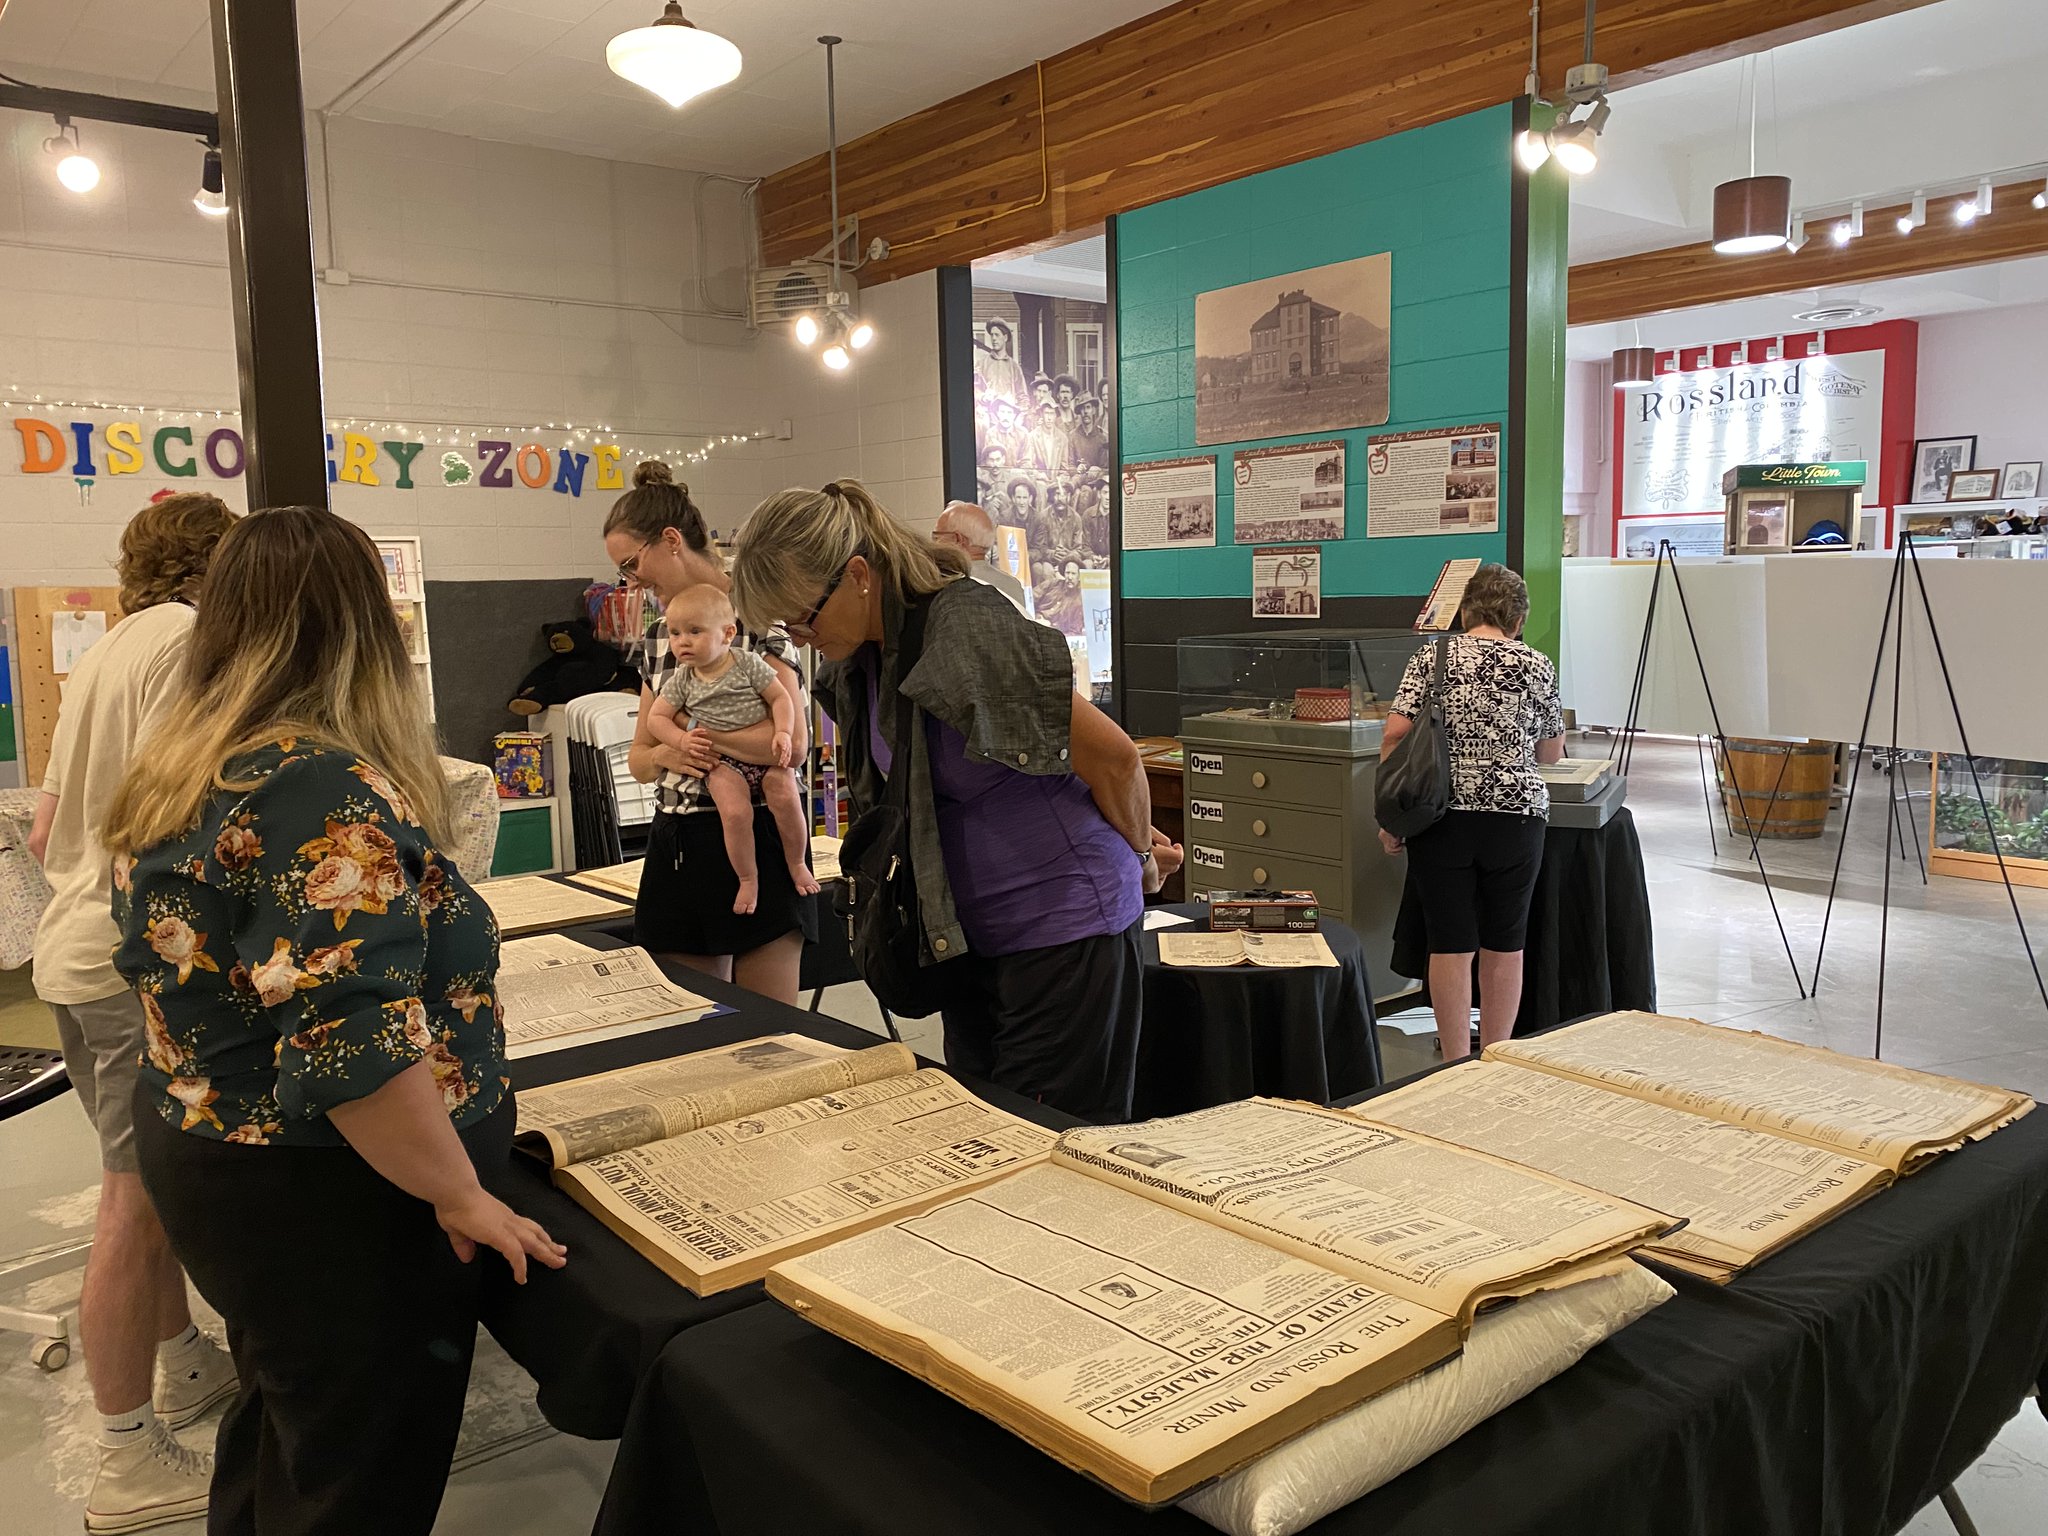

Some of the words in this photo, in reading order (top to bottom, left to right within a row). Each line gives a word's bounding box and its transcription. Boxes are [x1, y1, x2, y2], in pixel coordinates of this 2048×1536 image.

[1641, 362, 1801, 422] Rossland
[1406, 429, 1446, 439] Rossland
[15, 418, 424, 490] DISCORY
[478, 441, 624, 498] ZONE
[1762, 466, 1802, 481] Little
[1804, 464, 1841, 479] Town
[1192, 755, 1222, 772] Open
[1192, 802, 1222, 818] Open
[1194, 847, 1223, 865] Open
[1287, 921, 1303, 929] 100
[949, 1137, 1001, 1159] SALE
[1315, 1133, 1389, 1158] Crescent
[940, 1150, 981, 1169] REXALL
[1281, 1156, 1324, 1168] Dry
[1838, 1160, 1867, 1175] THE
[593, 1163, 632, 1184] NUT
[613, 1160, 653, 1186] October
[1231, 1165, 1291, 1180] Goods
[1274, 1177, 1331, 1192] HUNTER
[1784, 1176, 1843, 1211] ROSSLAND
[614, 1181, 668, 1215] ANNUAL
[643, 1184, 695, 1218] THURSDAY,
[1229, 1189, 1278, 1206] BROS.
[652, 1210, 693, 1232] CLUB
[677, 1227, 736, 1261] ROTARY
[687, 1215, 748, 1253] WEDNESDAY,
[1304, 1286, 1377, 1323] DEATH
[1235, 1320, 1267, 1335] THE
[1269, 1321, 1312, 1342] OF
[1354, 1311, 1411, 1340] THE
[1185, 1336, 1228, 1359] END
[1216, 1340, 1273, 1366] HER
[1245, 1340, 1360, 1394] ROSSLAND
[1104, 1365, 1221, 1420] MAJESTY.
[1161, 1395, 1248, 1435] MINER.
